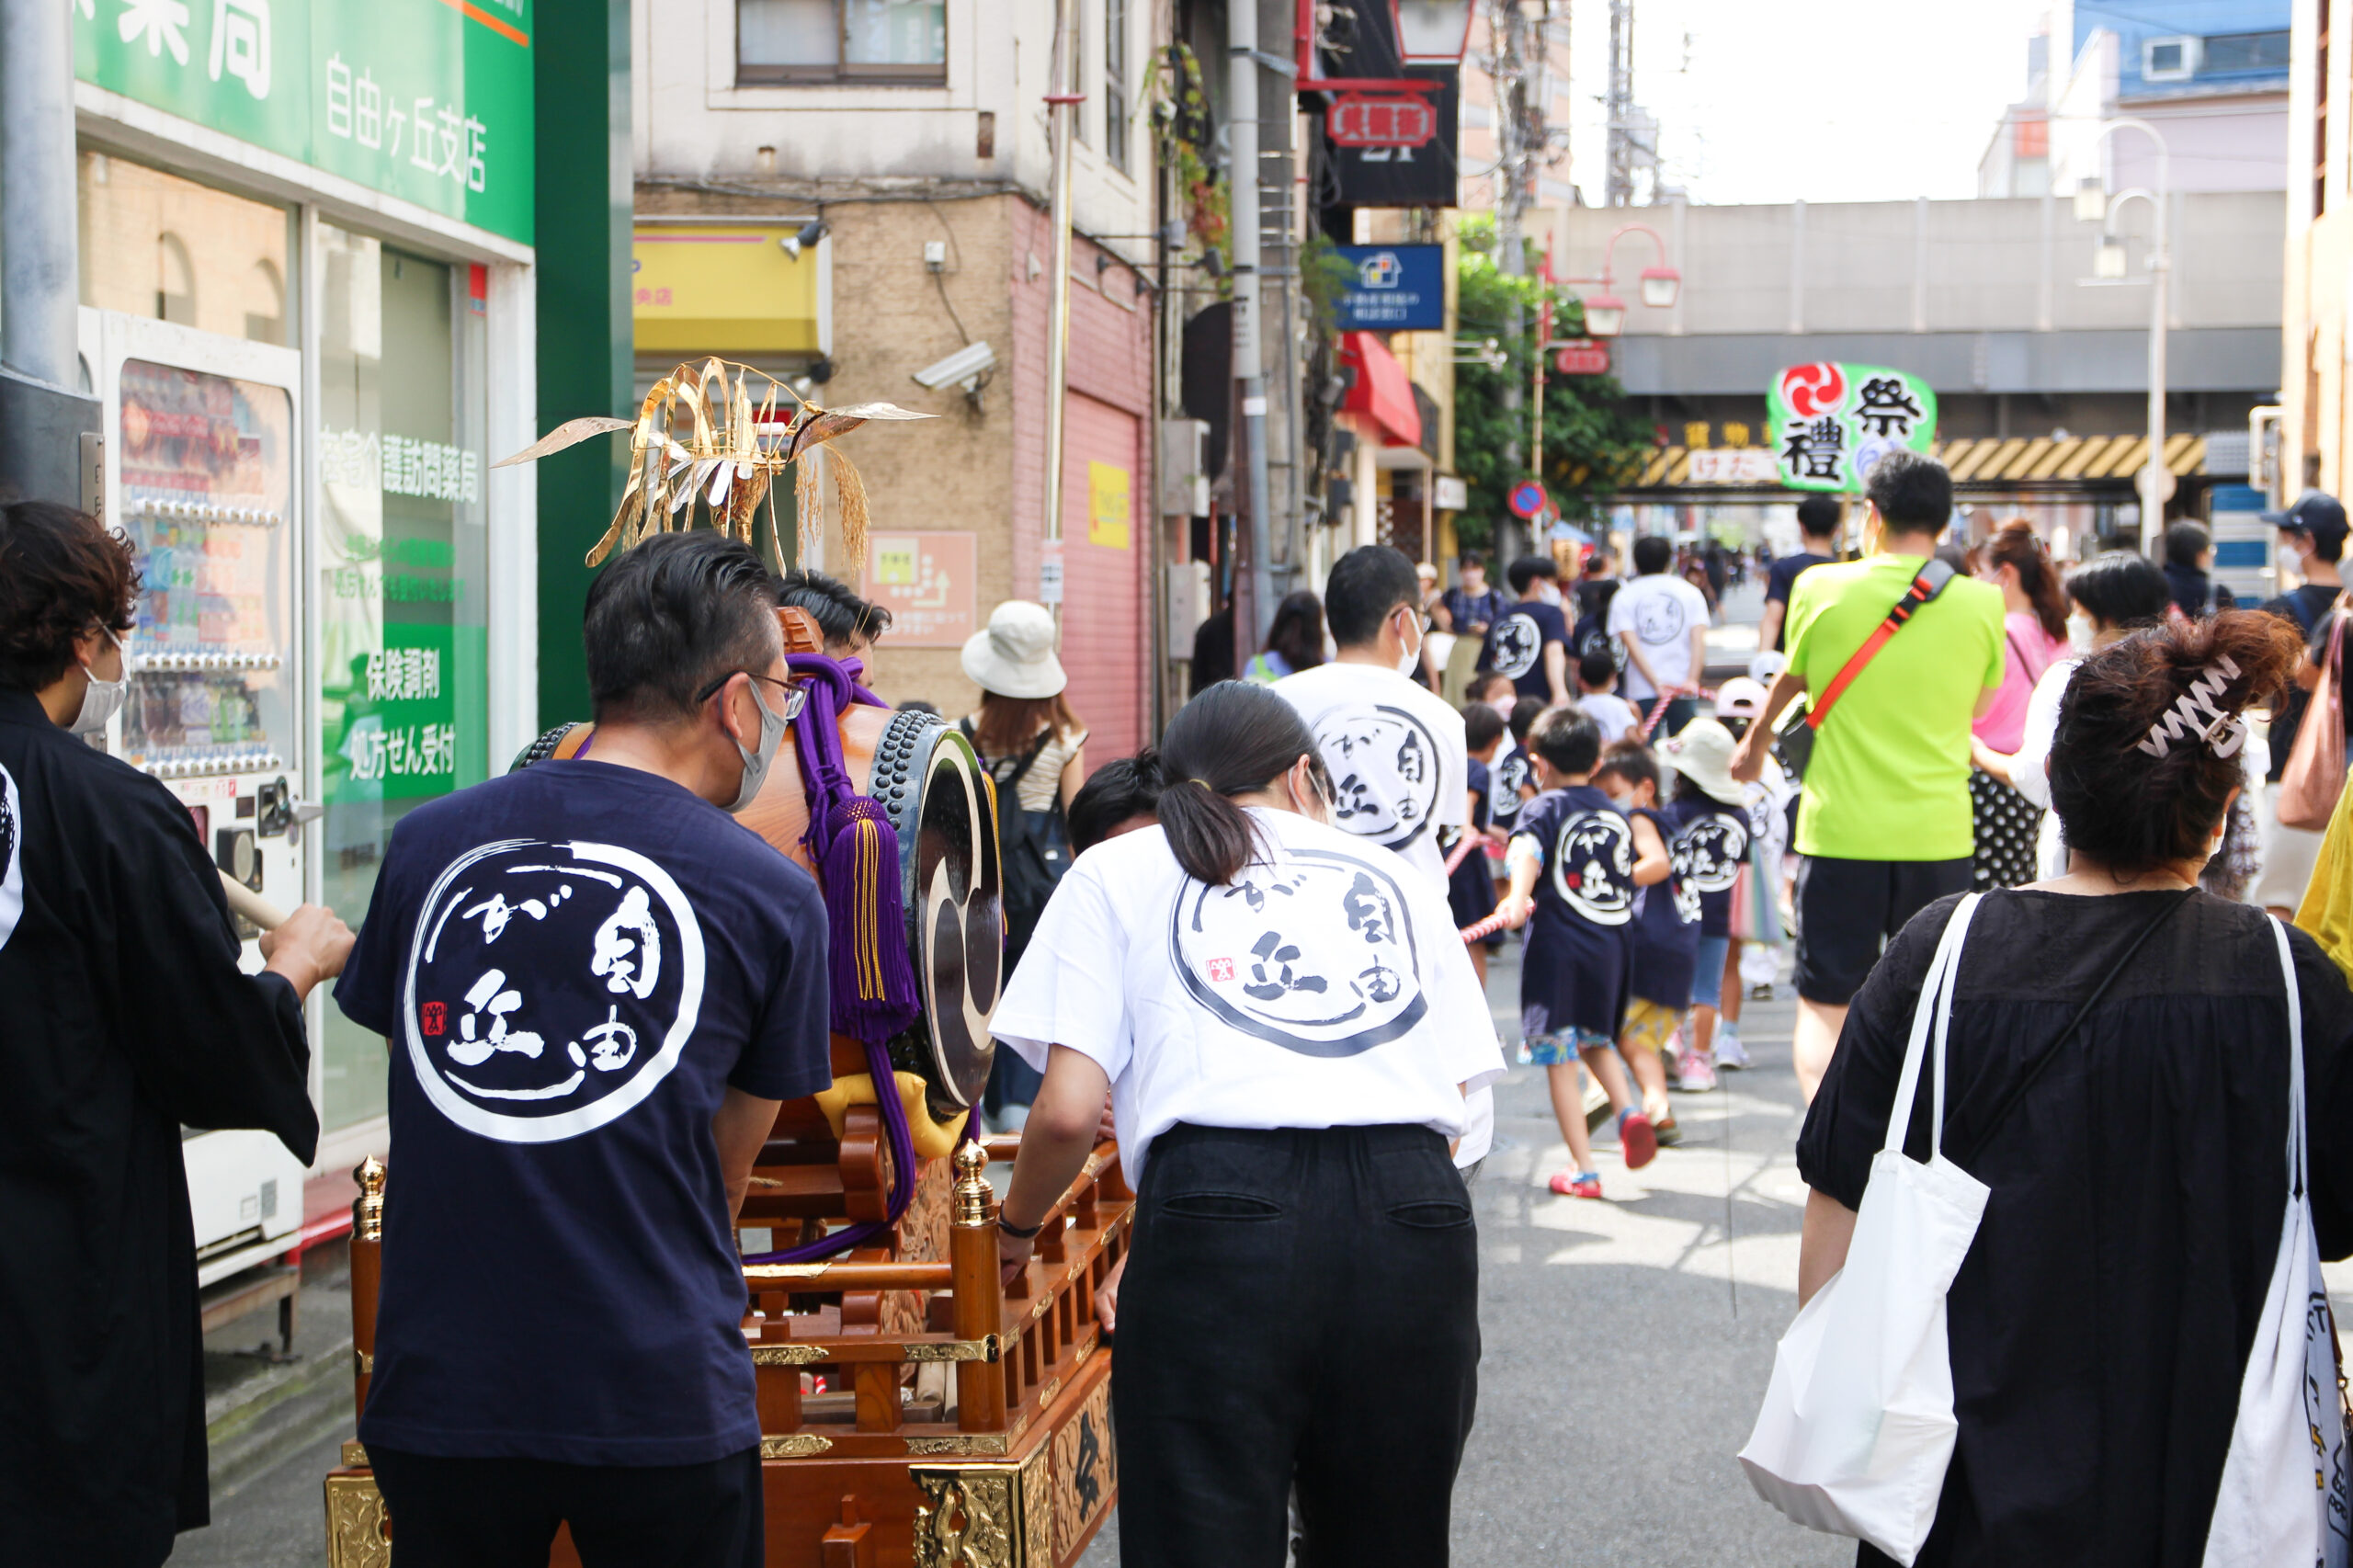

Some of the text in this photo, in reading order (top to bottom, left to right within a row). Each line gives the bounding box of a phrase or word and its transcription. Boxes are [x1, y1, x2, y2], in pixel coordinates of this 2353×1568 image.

[1781, 378, 1921, 483] 祭 禮
[366, 648, 440, 701] 保険調剤
[349, 723, 456, 781] 処方せん受付
